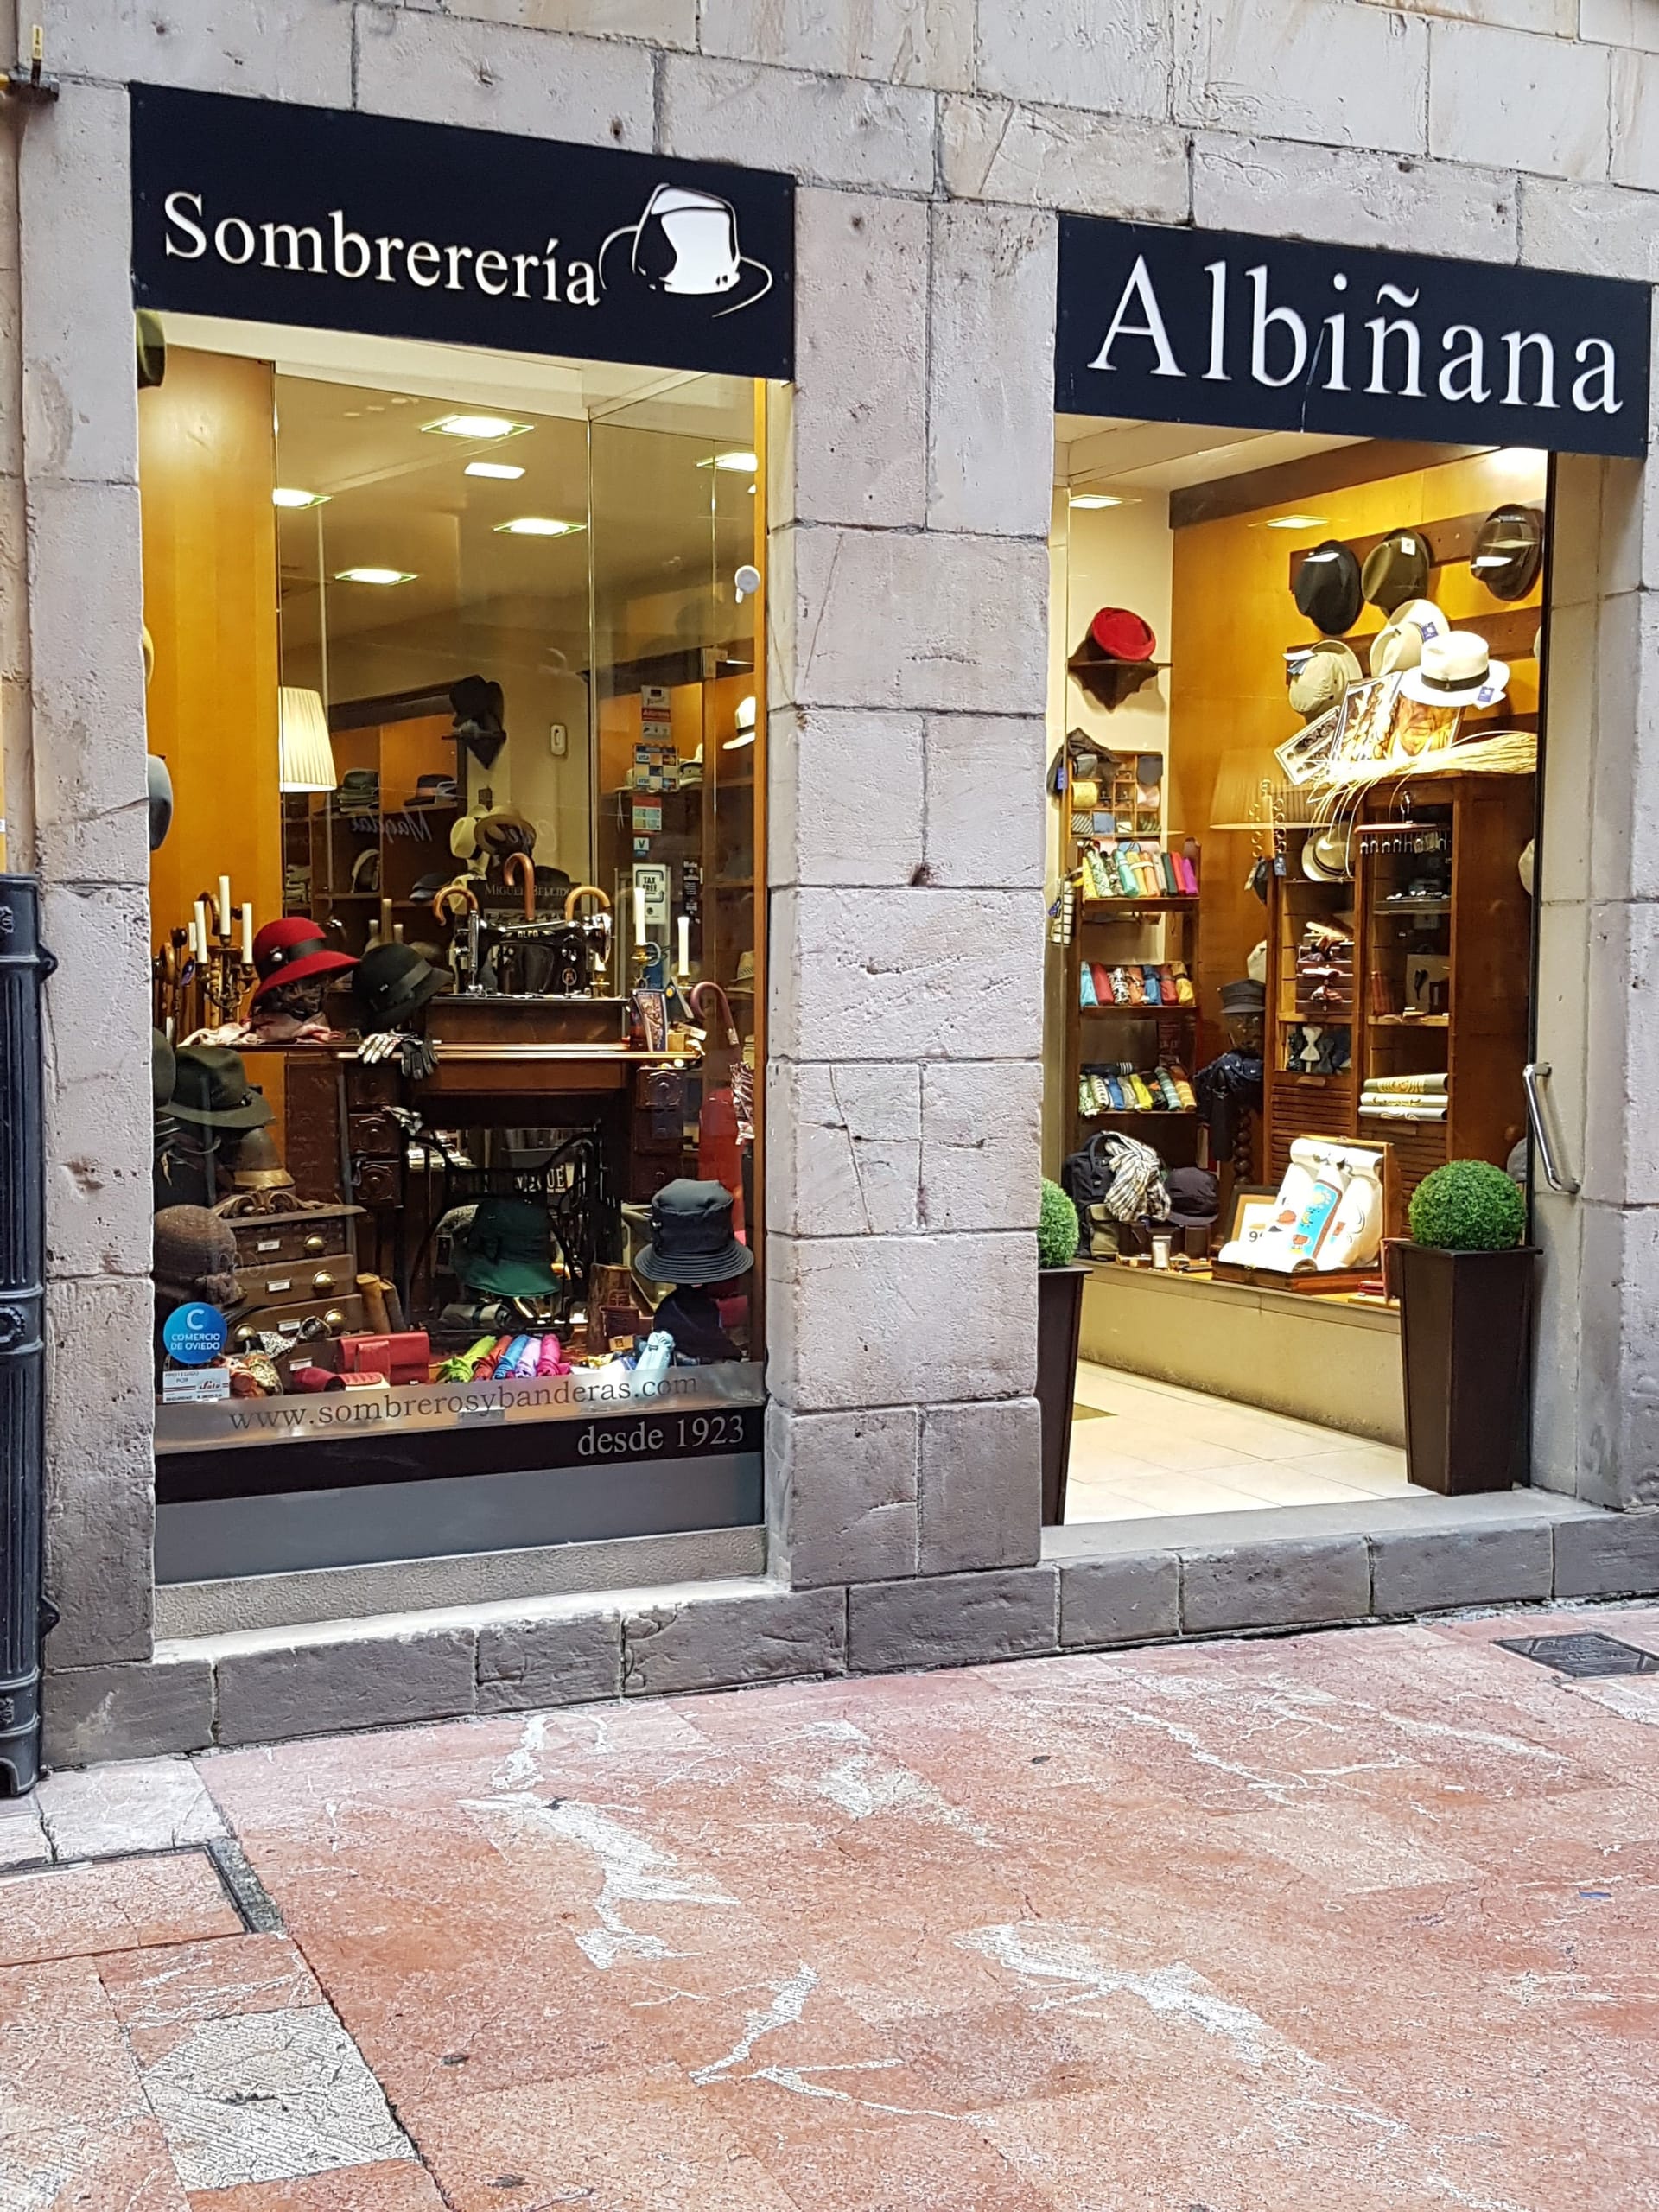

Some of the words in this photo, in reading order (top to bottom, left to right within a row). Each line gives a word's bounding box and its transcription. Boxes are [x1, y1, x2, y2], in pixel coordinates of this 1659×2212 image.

[163, 190, 601, 308] Sombrerería
[1087, 253, 1624, 416] Albiñana
[171, 1333, 221, 1342] COMERCIO
[187, 1309, 205, 1331] C
[170, 1342, 183, 1351] DE
[185, 1342, 221, 1351] OVIEDO
[230, 1376, 697, 1430] www.sombrerosybanderas.com
[577, 1421, 664, 1456] desde
[677, 1414, 745, 1448] 1923
